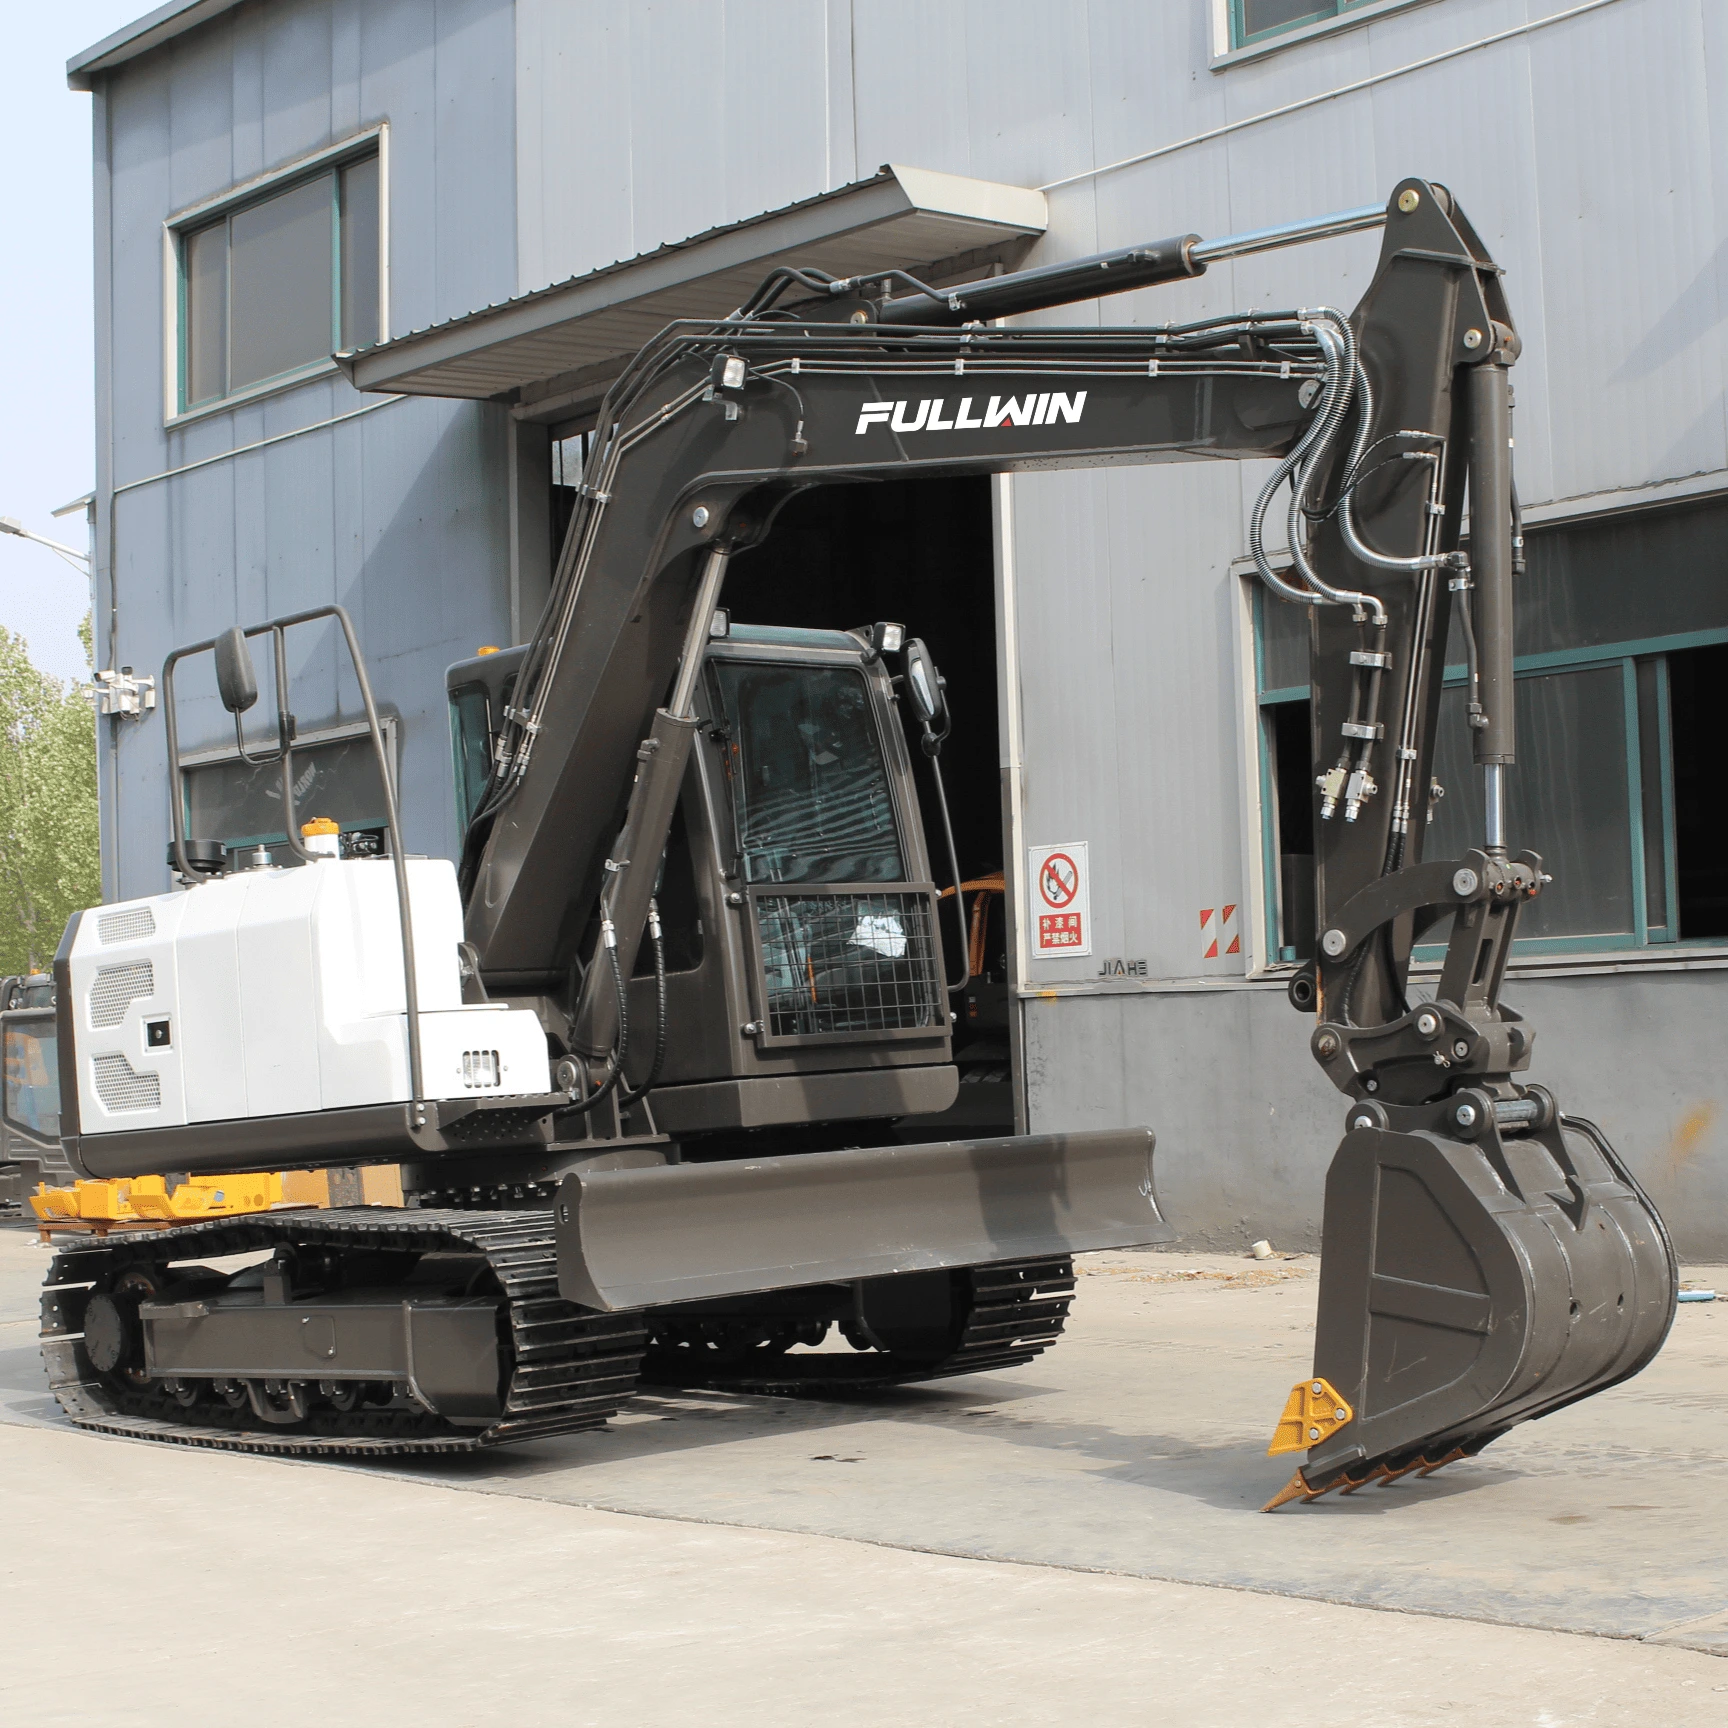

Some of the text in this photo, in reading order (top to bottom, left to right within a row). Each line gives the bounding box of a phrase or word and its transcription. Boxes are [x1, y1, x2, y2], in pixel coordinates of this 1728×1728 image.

[855, 391, 1088, 435] FULLWIN
[1042, 930, 1079, 945] 严禁烟火
[1098, 959, 1147, 976] JIAHE
